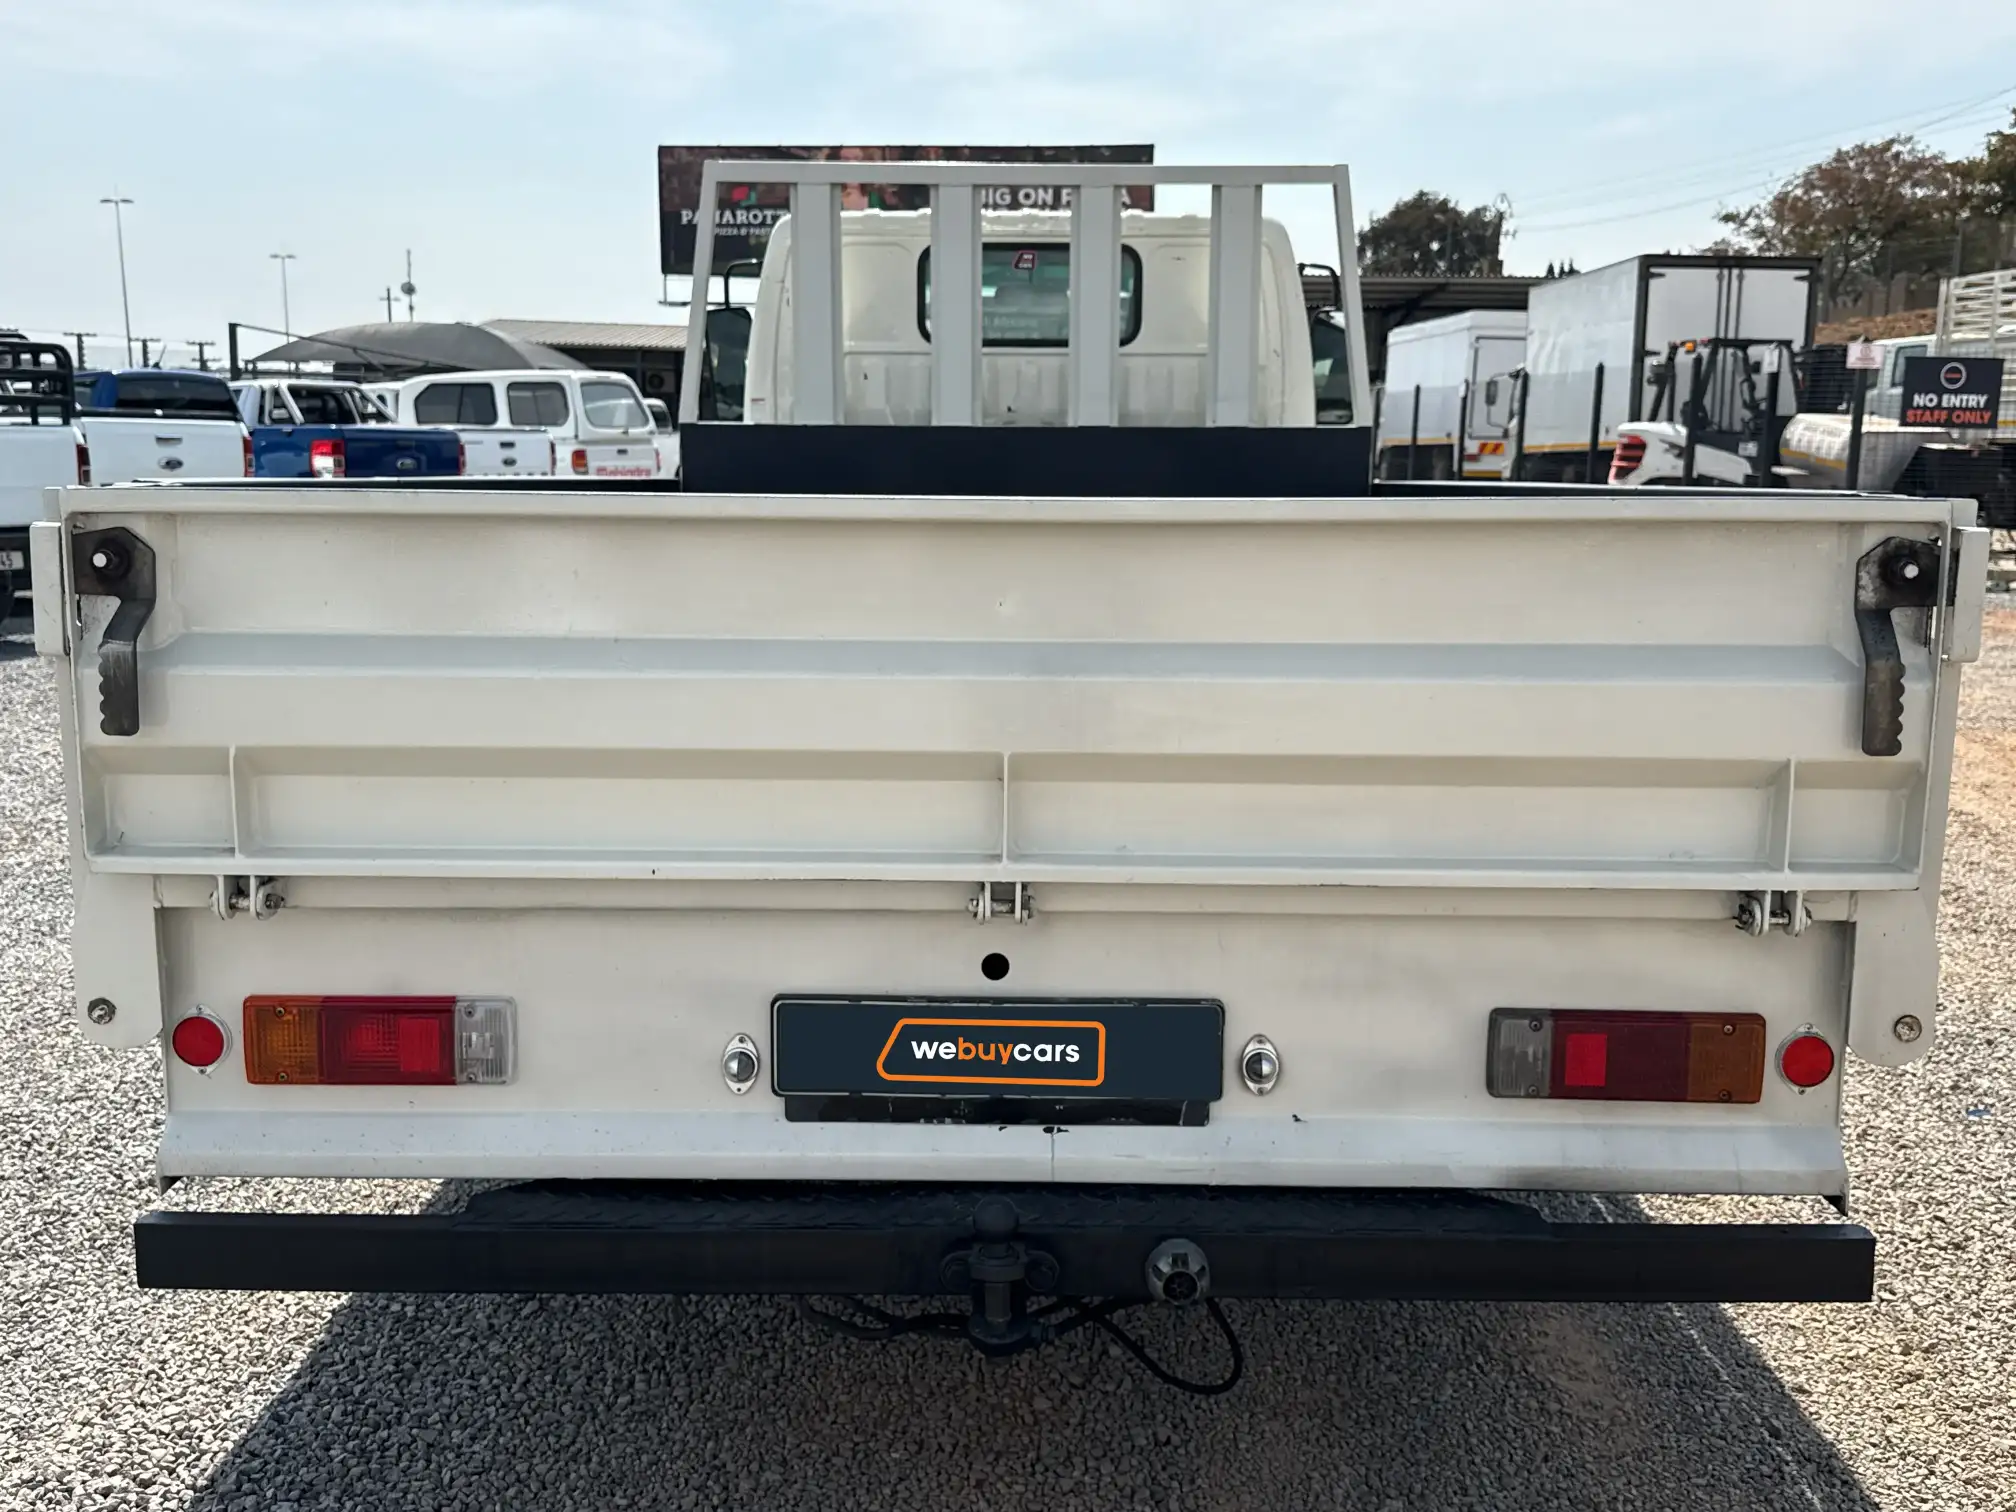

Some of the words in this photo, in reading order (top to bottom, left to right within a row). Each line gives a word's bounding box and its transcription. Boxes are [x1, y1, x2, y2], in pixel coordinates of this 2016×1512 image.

[1018, 187, 1053, 206] ON
[1912, 393, 1938, 408] NO
[1941, 393, 1989, 408] ENTRY
[1906, 410, 1948, 424] STAFF
[1951, 411, 1992, 424] ONLY
[911, 1037, 1080, 1065] webuycars
